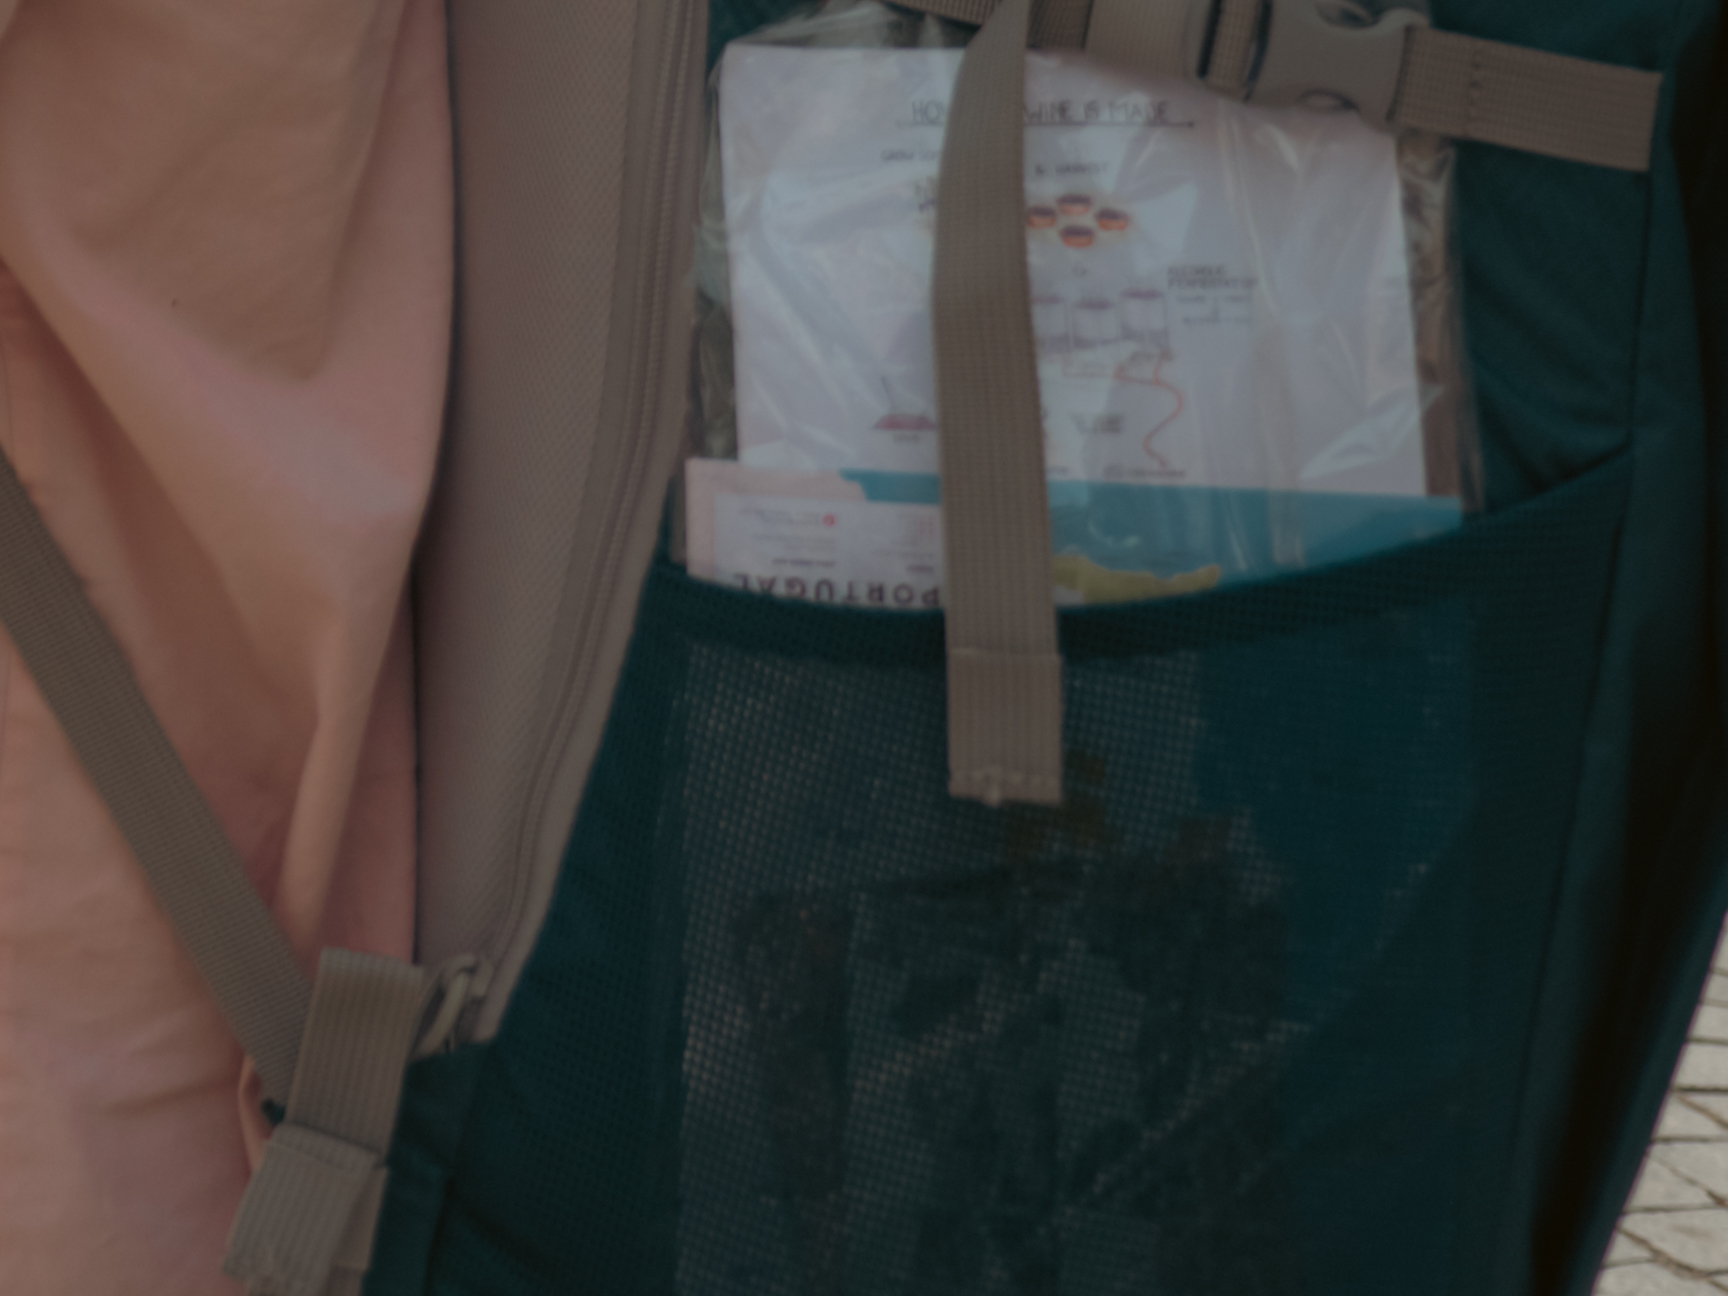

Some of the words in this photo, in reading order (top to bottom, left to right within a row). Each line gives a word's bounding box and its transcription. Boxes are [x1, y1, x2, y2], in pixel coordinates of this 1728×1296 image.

[911, 100, 946, 123] HO
[1108, 99, 1169, 123] MADE
[734, 573, 941, 607] PORTUGAL
